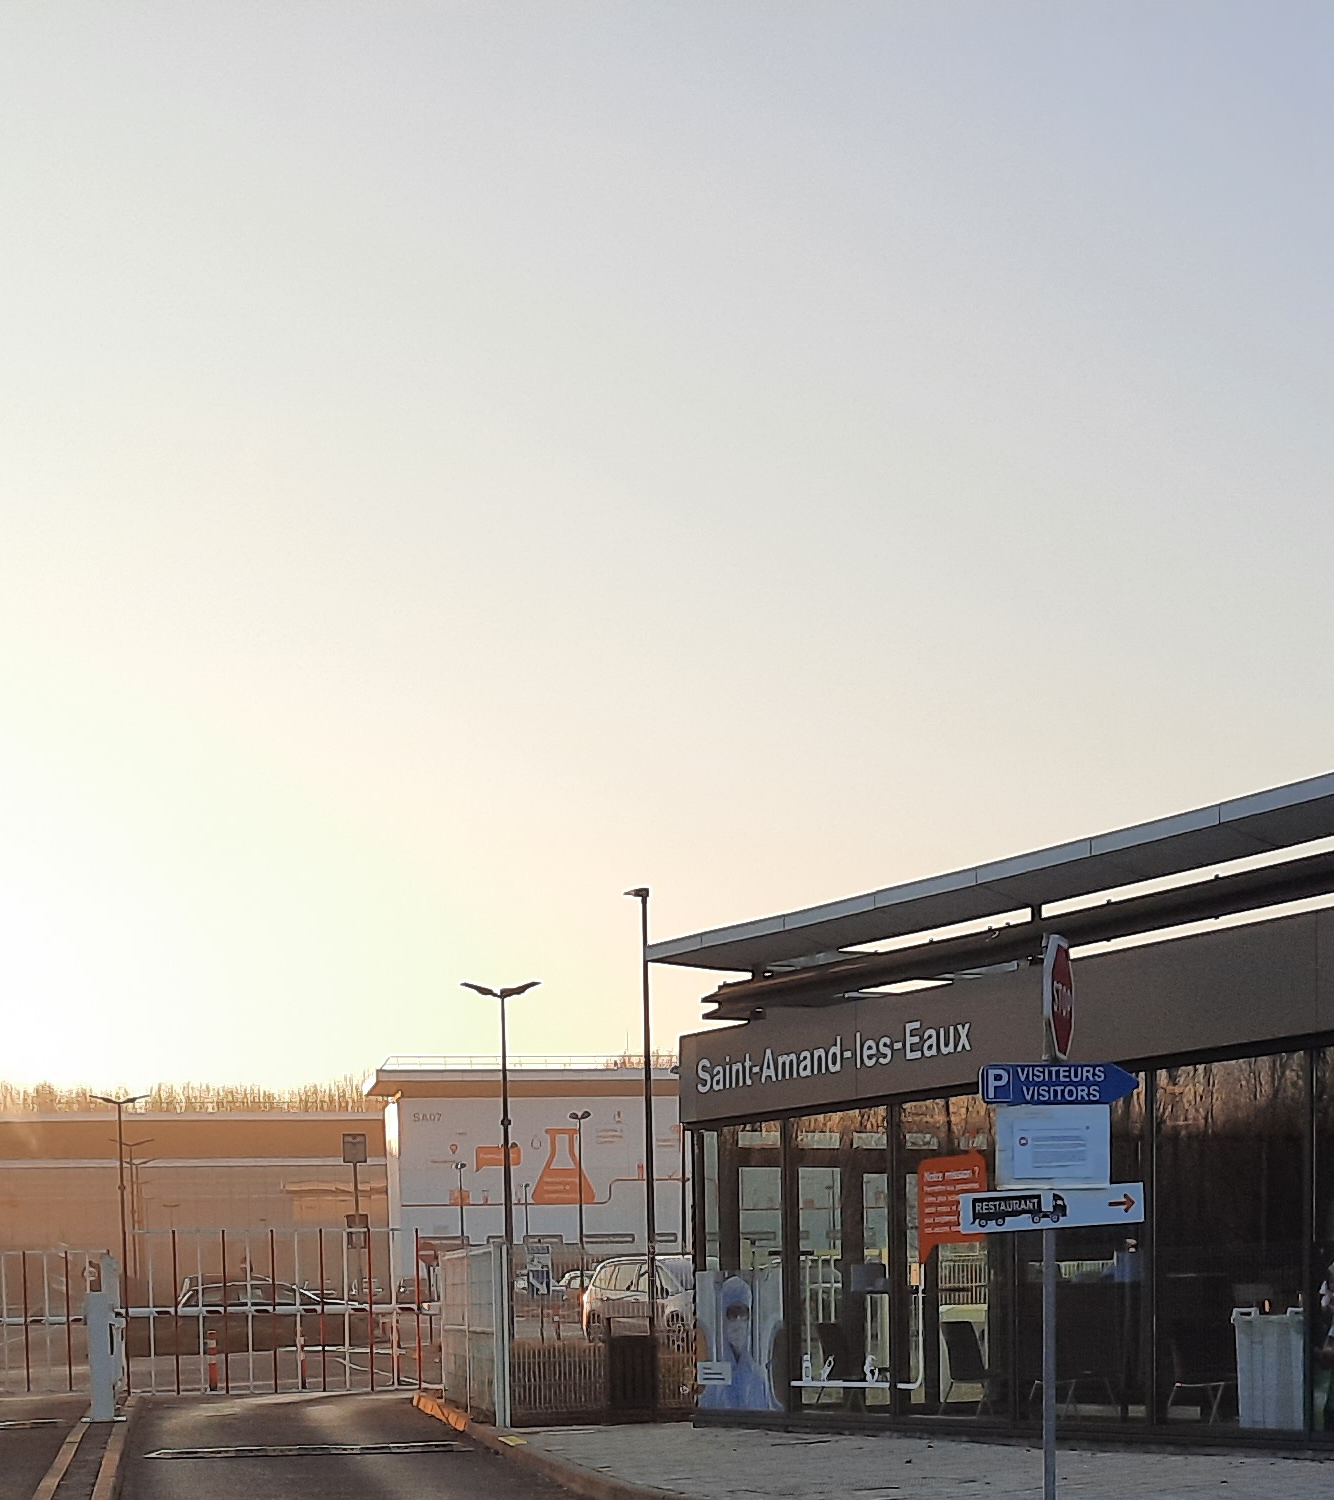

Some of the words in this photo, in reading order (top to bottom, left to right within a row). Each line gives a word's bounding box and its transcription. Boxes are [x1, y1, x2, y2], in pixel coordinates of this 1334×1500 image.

[696, 1020, 972, 1094] Saint-Amand-les-Eaux
[1017, 1066, 1106, 1082] VISITEURS
[987, 1068, 1009, 1099] P
[1022, 1085, 1101, 1101] VISITORS
[412, 1112, 442, 1123] SA07
[975, 1198, 1040, 1214] RESTAURANT
